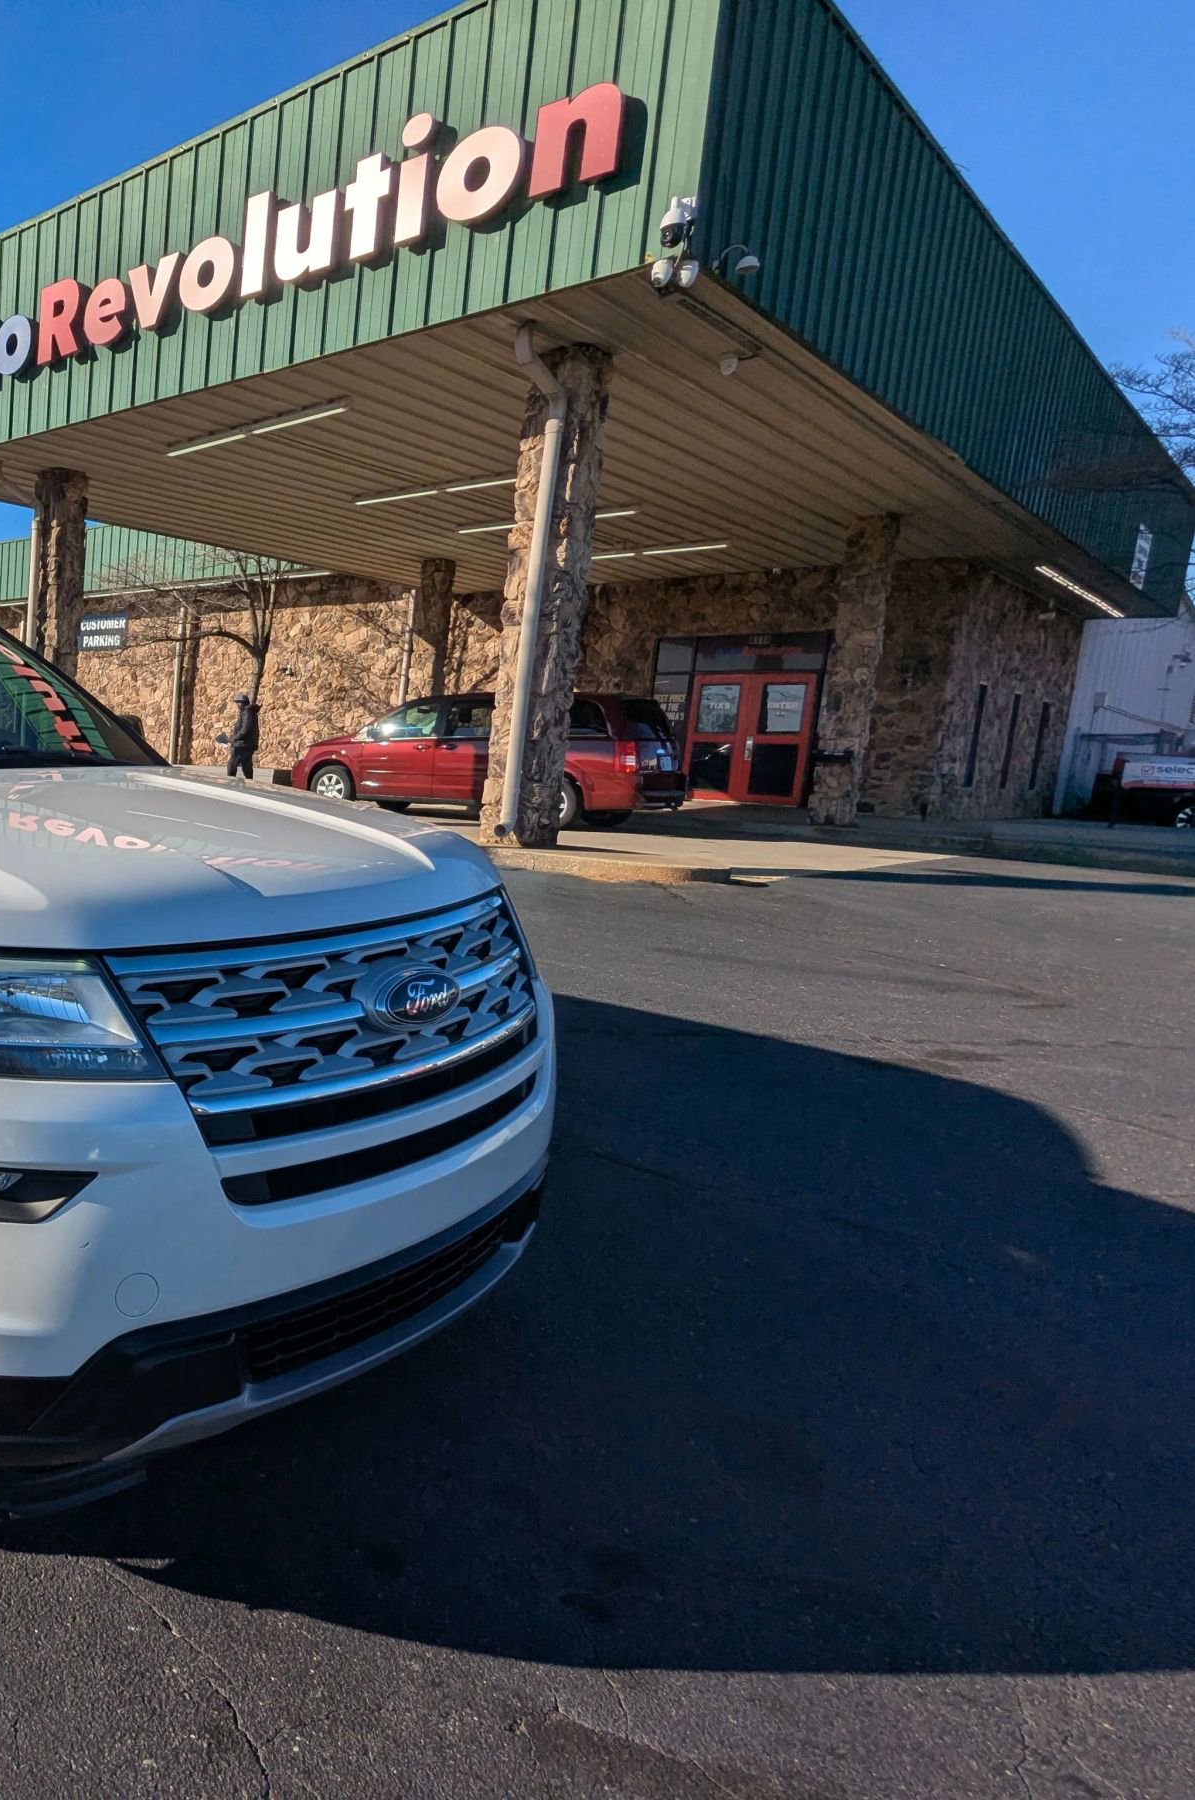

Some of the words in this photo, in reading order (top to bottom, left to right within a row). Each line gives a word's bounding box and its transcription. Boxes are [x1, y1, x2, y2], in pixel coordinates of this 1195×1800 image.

[80, 617, 126, 631] CUSTOMER
[82, 635, 121, 648] PARKING
[405, 978, 449, 1016] Ford
